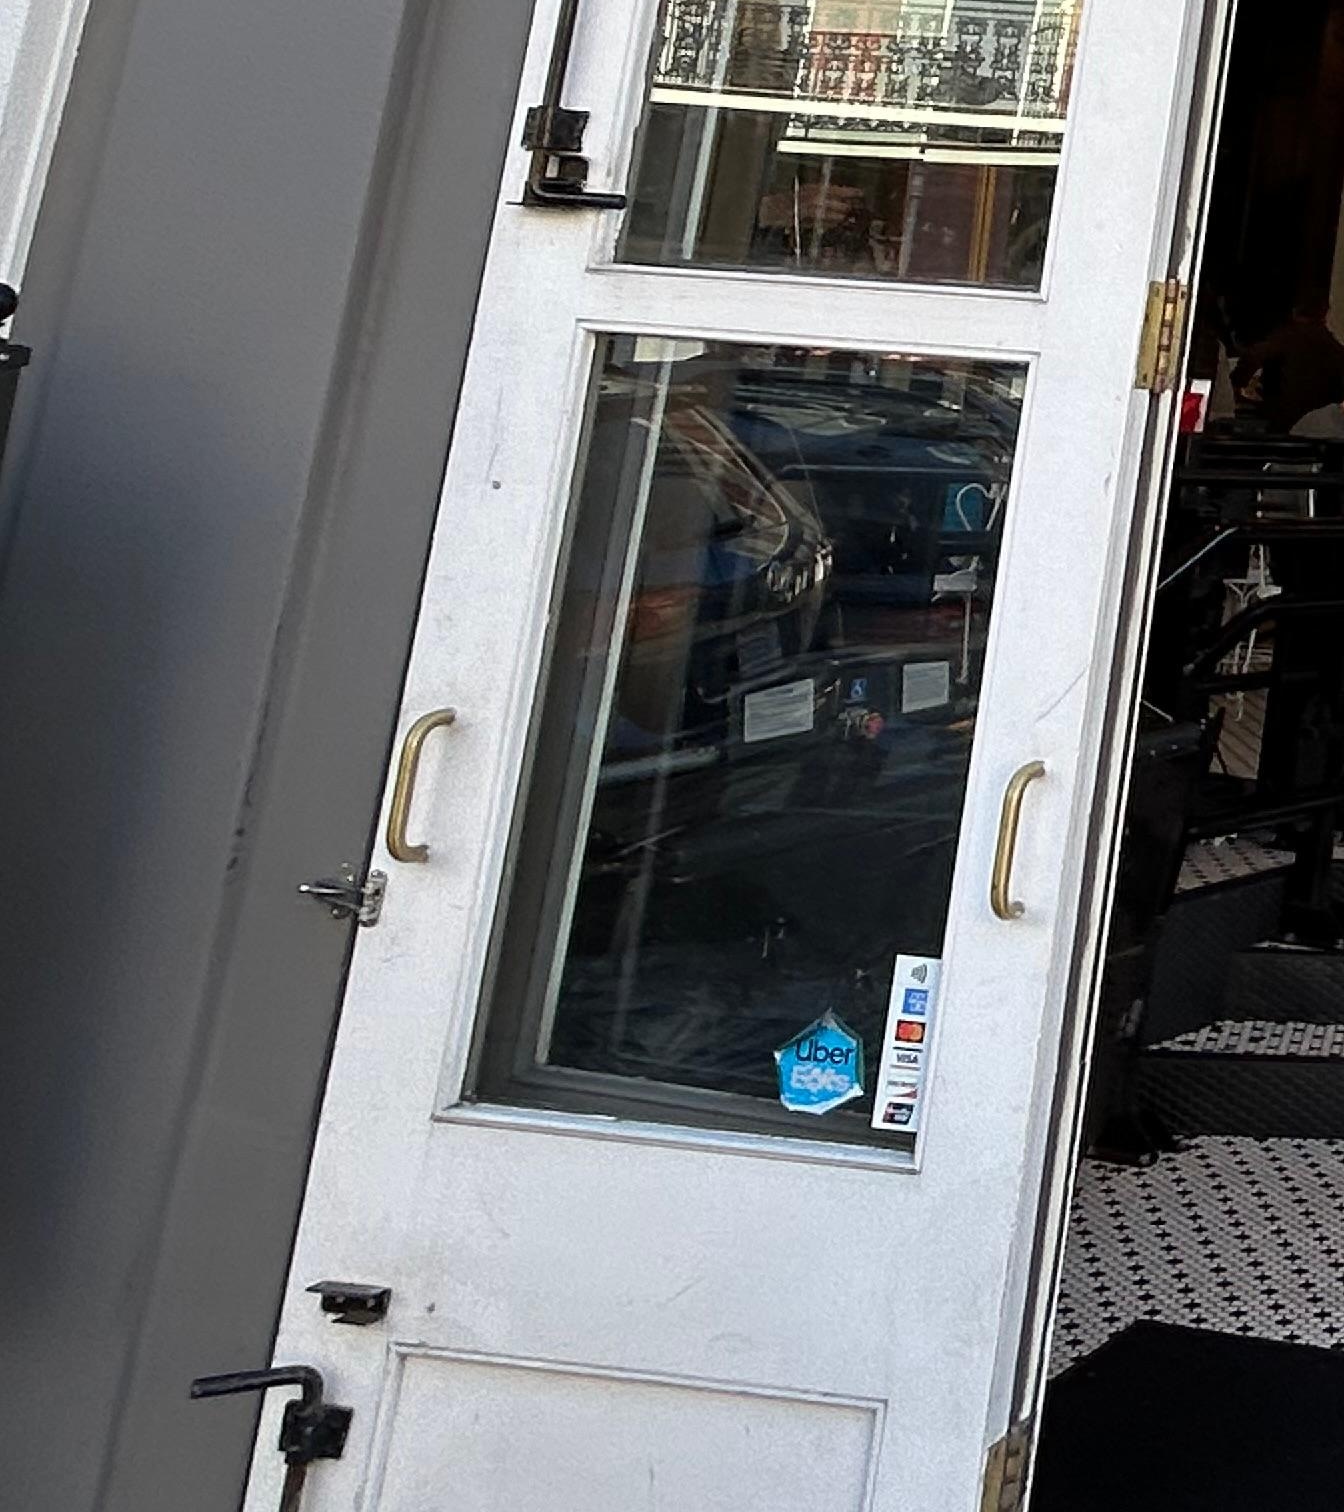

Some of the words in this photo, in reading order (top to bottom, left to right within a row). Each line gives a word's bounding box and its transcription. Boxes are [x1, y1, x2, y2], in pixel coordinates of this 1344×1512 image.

[796, 1039, 854, 1065] Uber
[896, 1053, 919, 1065] VISA
[791, 1064, 851, 1093] Eats
